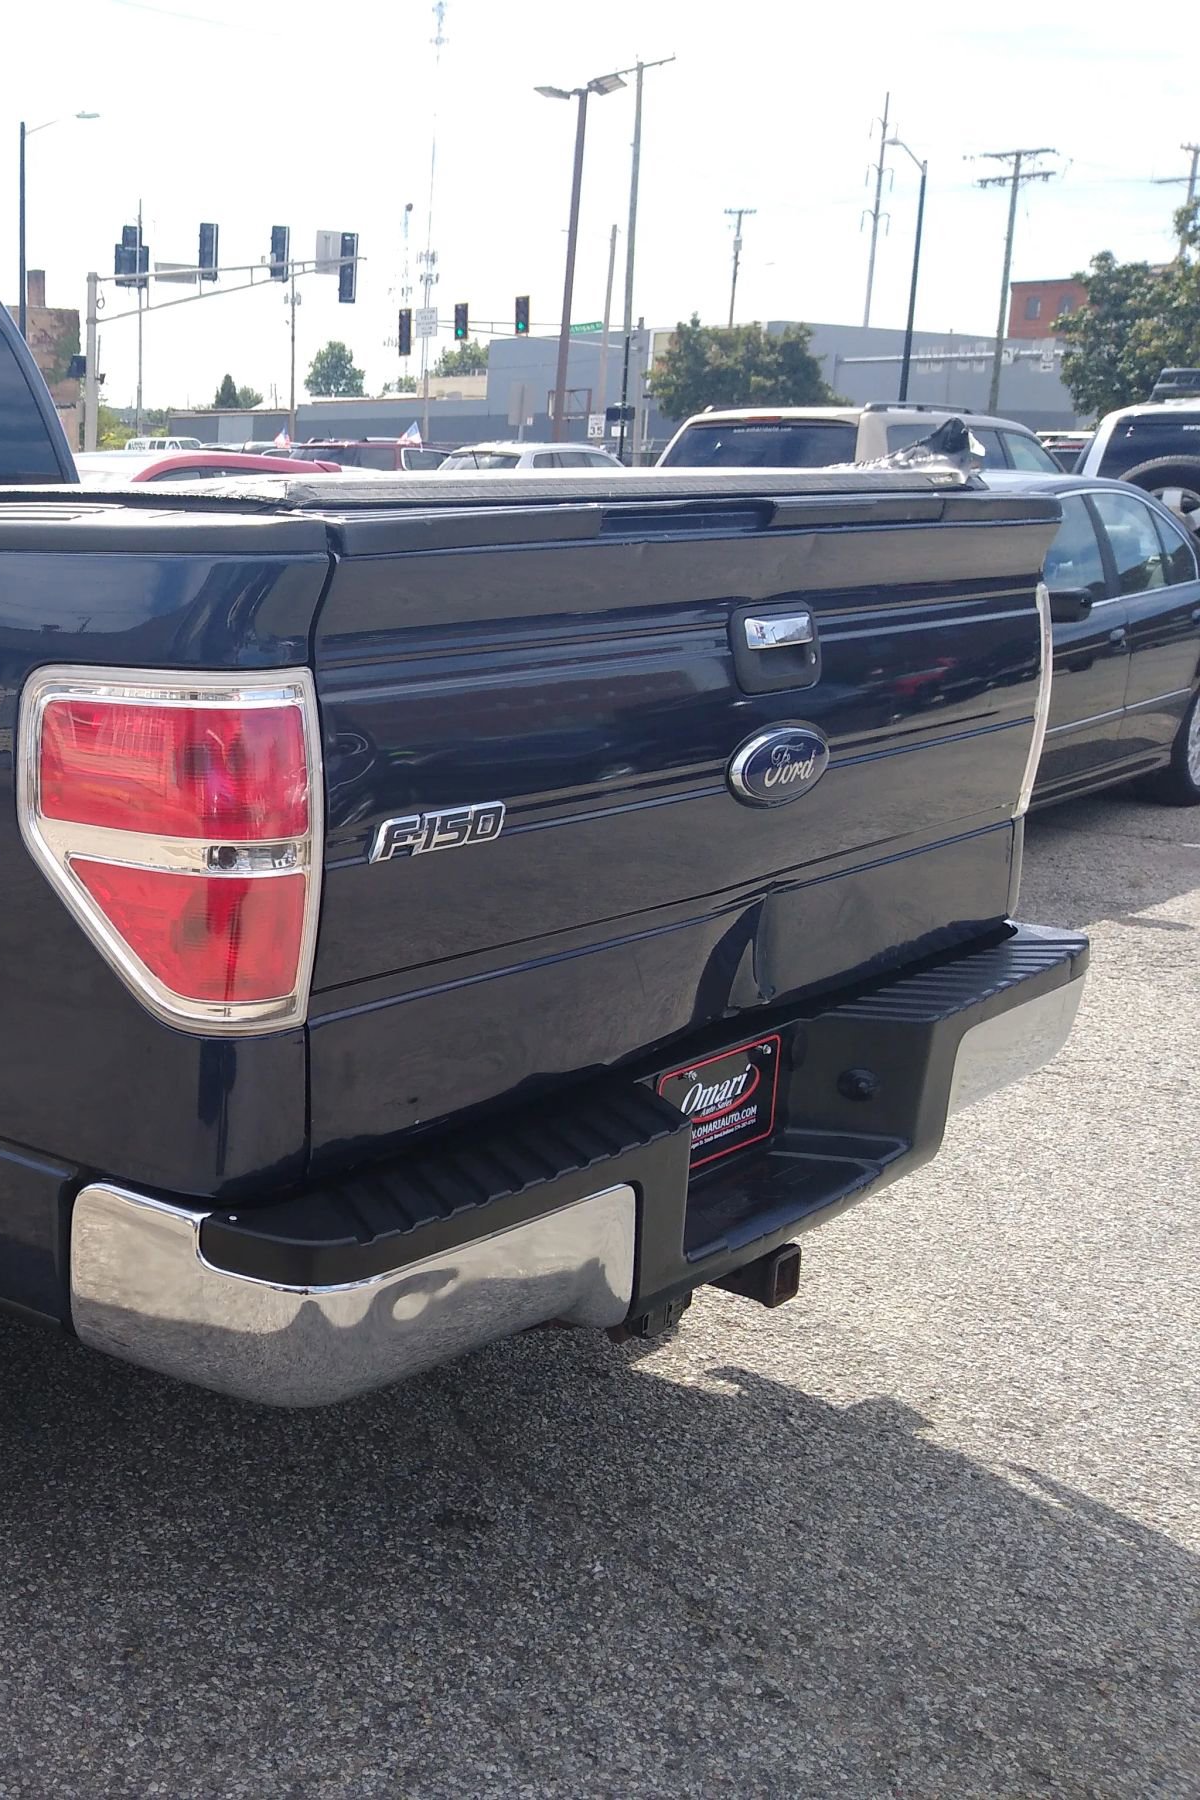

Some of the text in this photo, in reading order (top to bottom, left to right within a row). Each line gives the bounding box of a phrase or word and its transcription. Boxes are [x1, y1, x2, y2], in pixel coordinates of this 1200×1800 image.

[589, 425, 604, 437] 35
[764, 742, 817, 788] Ford
[368, 800, 506, 864] F-150
[681, 1063, 752, 1116] Omari
